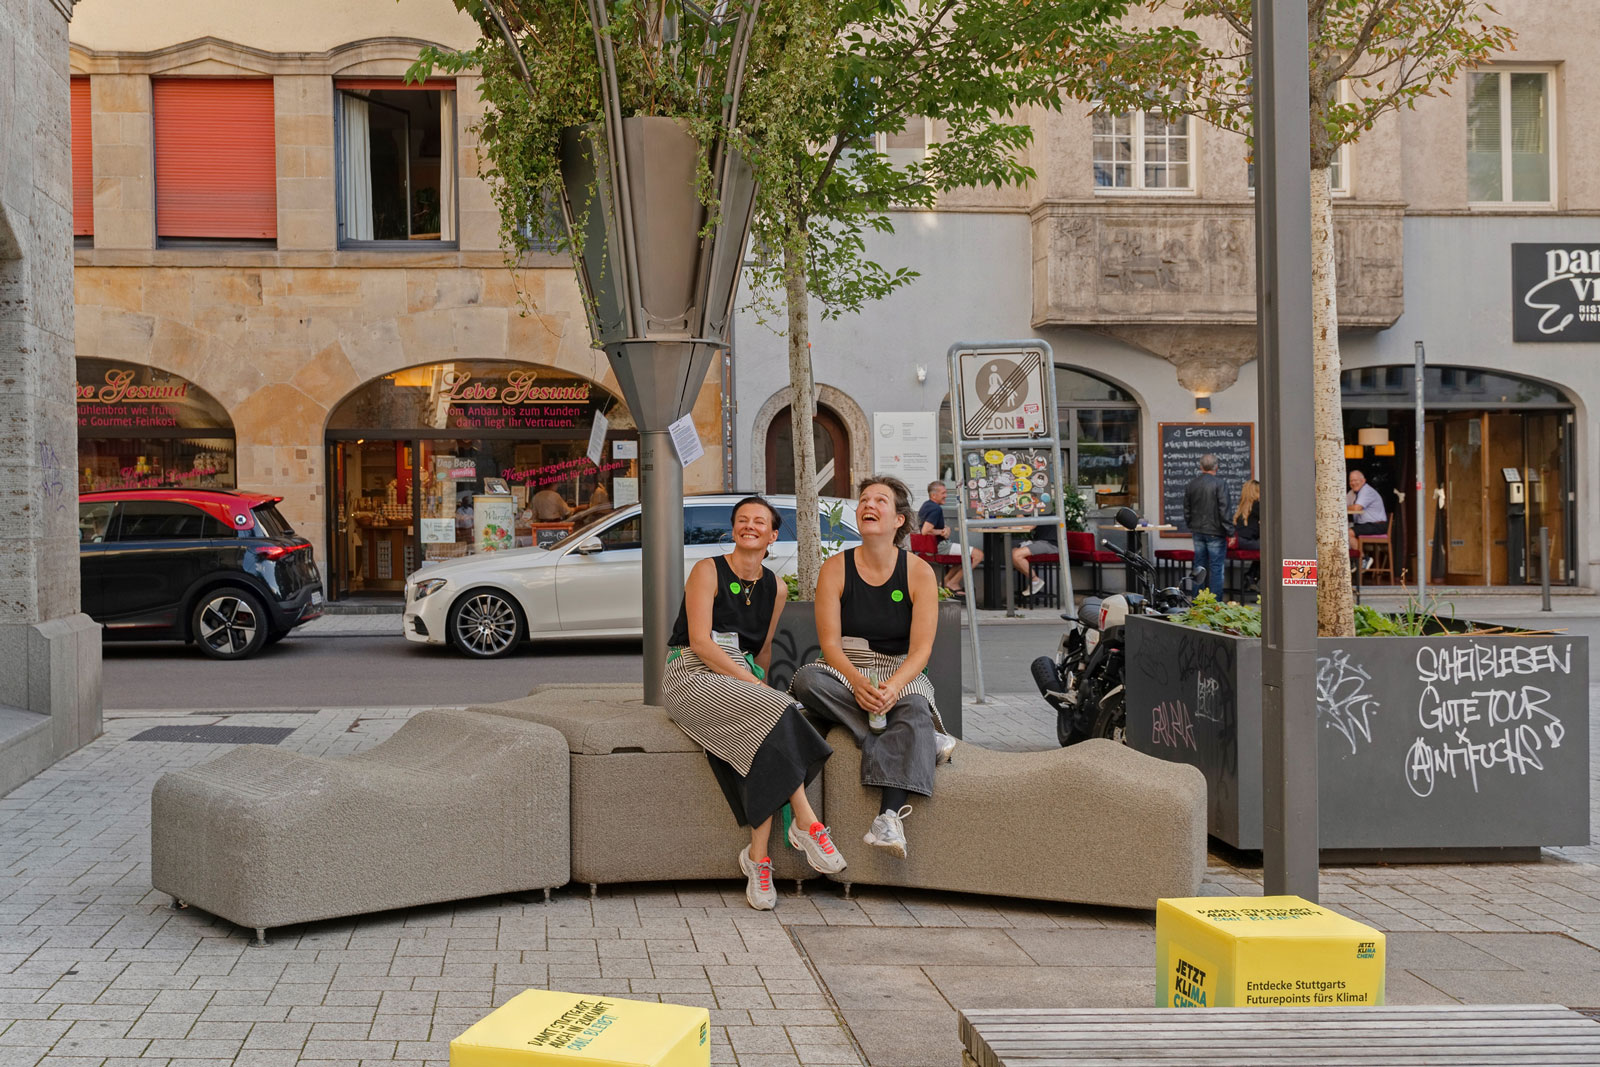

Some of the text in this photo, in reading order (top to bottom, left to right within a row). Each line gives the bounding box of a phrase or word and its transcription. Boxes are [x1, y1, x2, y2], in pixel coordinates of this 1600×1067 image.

[98, 369, 188, 404] Gesund
[440, 370, 590, 405] Lebe Gesund
[131, 404, 148, 415] wie
[443, 407, 466, 416] Vom
[468, 406, 498, 416] Anbau
[502, 406, 516, 416] bis
[519, 408, 541, 416] zum
[543, 406, 580, 416] Kunden
[90, 417, 176, 426] Gourmet-Feinkost
[456, 417, 575, 429] darin liegt Ihr Vertrauen.
[985, 416, 1015, 430] ZON
[501, 456, 592, 481] Vegan-vegetarisc
[1419, 685, 1481, 732] GUTE
[1472, 685, 1561, 727] TOUR
[1176, 958, 1207, 986] JETZT
[1175, 976, 1207, 1008] KLIMA
[1247, 980, 1346, 992] Entdecke Stuttgarts
[1247, 992, 1368, 1005] Futurepoints fürs Klima!
